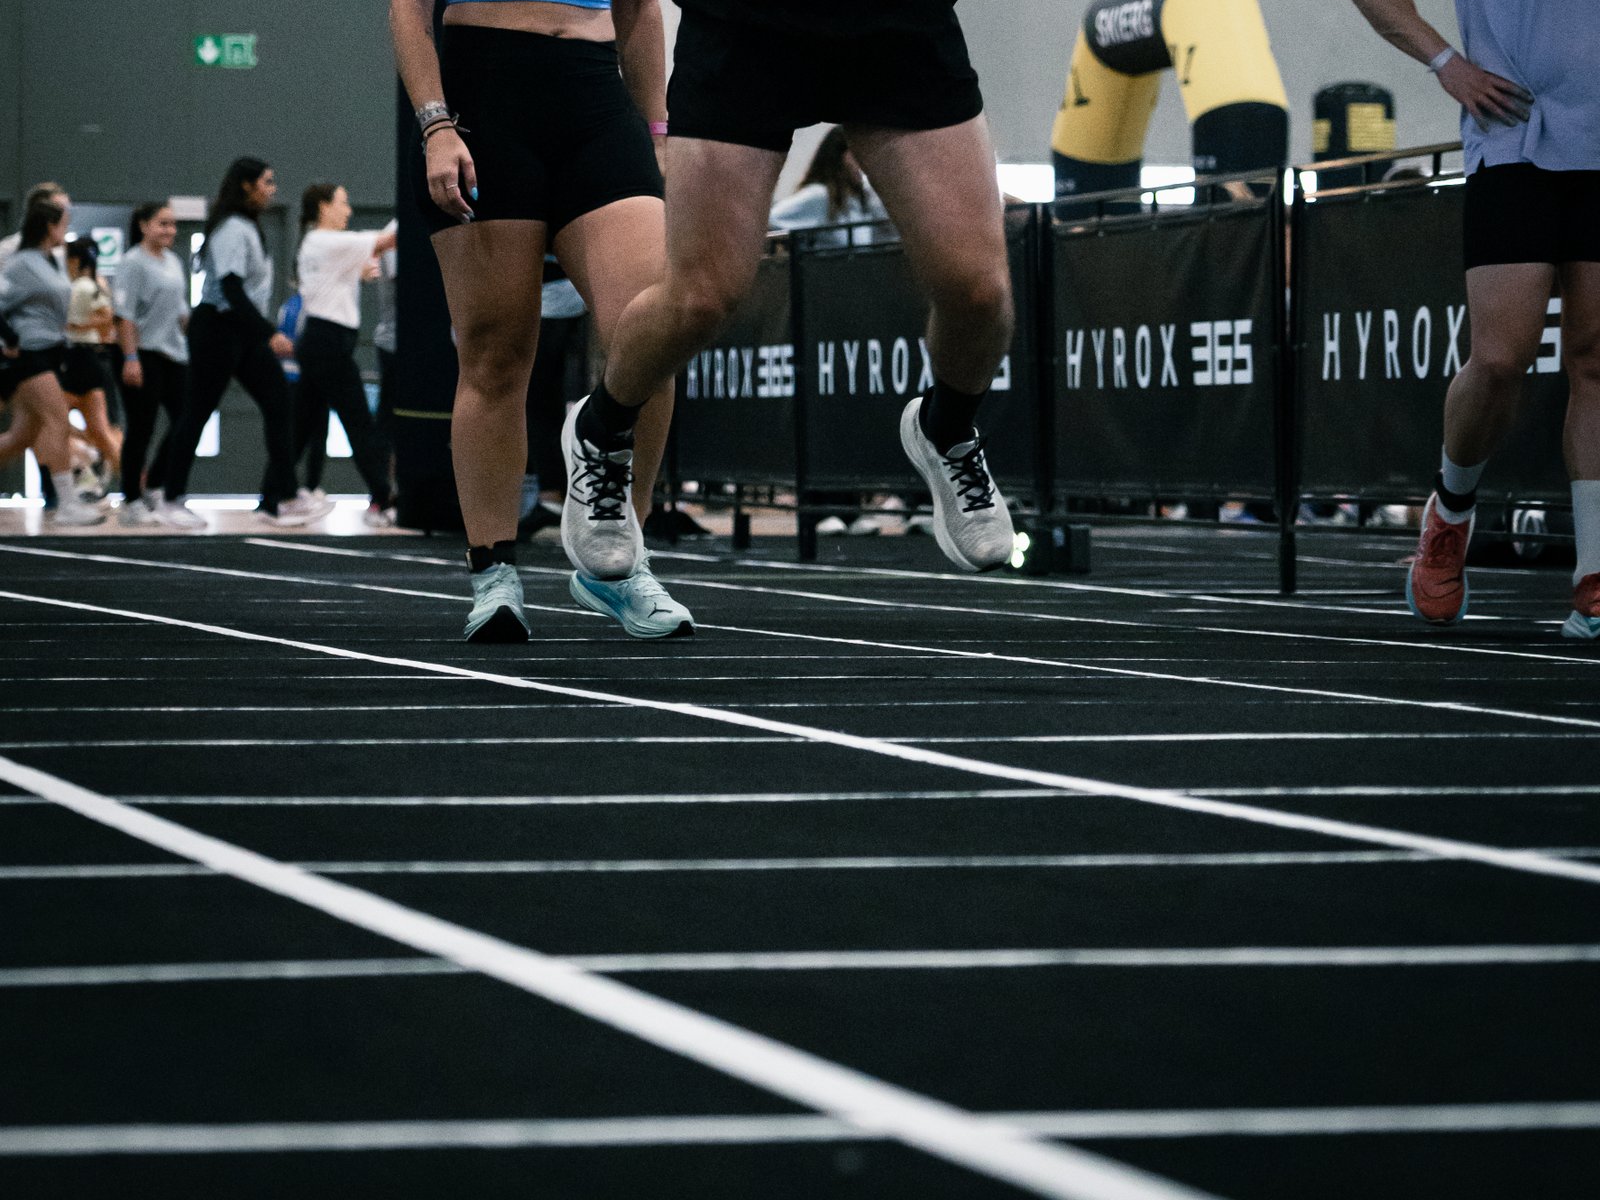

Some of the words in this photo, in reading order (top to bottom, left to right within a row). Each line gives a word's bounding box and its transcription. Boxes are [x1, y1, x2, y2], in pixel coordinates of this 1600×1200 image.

[687, 347, 753, 399] HYROX
[758, 344, 795, 398] 365
[818, 337, 935, 395] HYROX
[1066, 324, 1179, 389] HYROX
[1190, 319, 1254, 386] 365
[1322, 304, 1466, 380] HYROX
